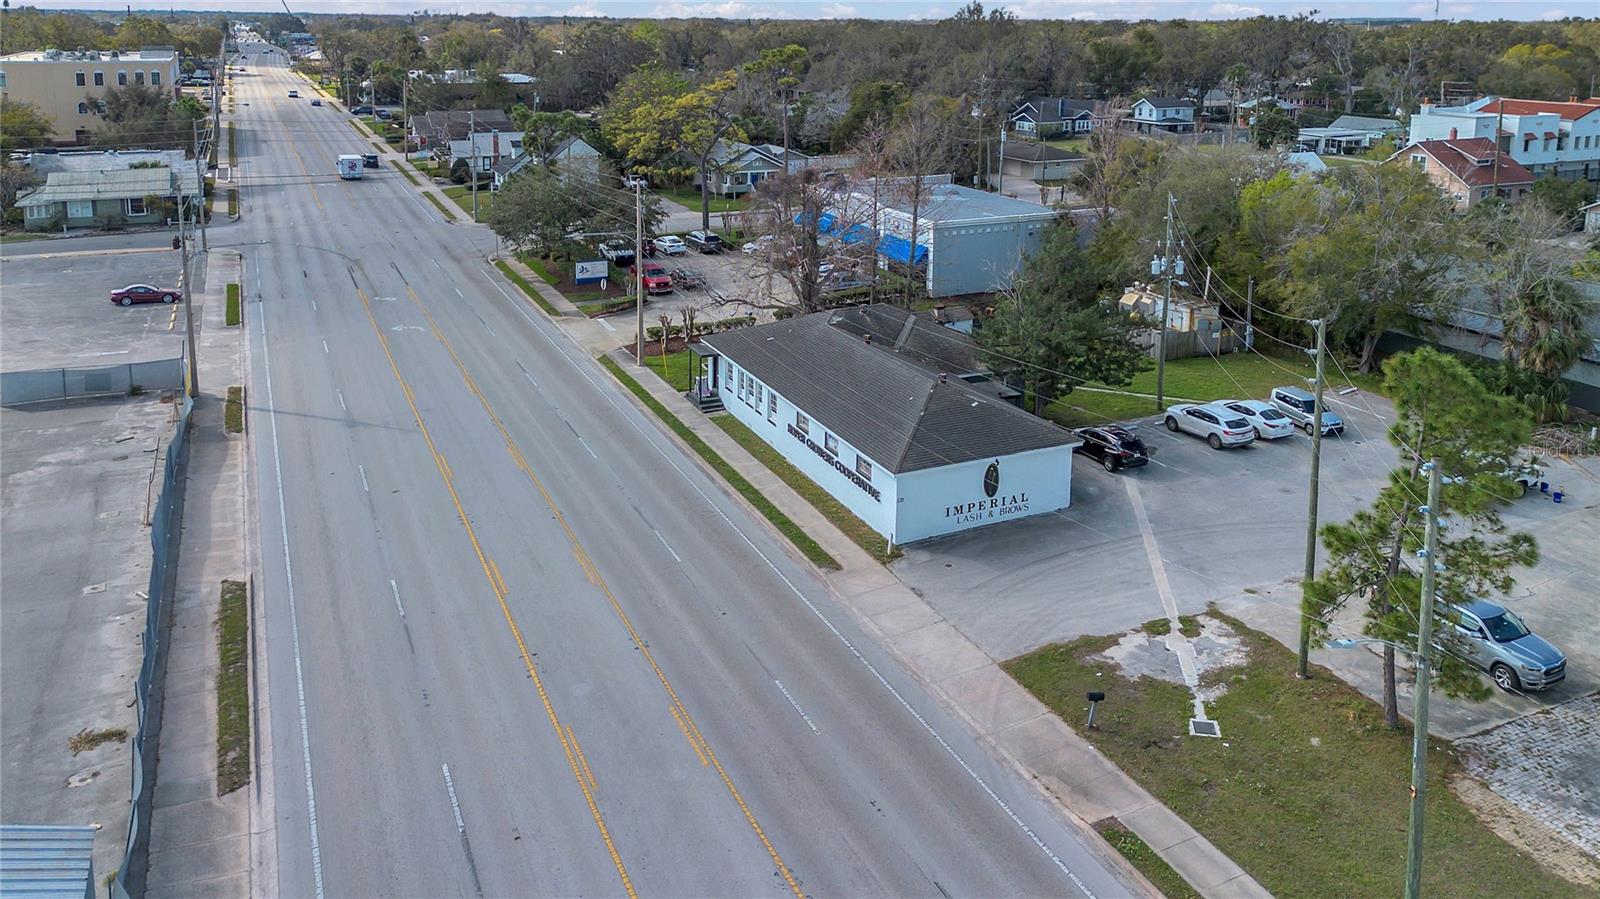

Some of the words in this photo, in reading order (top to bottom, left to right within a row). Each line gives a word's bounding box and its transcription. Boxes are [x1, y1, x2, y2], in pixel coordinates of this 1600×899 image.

[945, 493, 1029, 518] IMPERIAL
[957, 512, 983, 524] LASH
[987, 510, 994, 518] &
[999, 503, 1030, 516] BROWS
